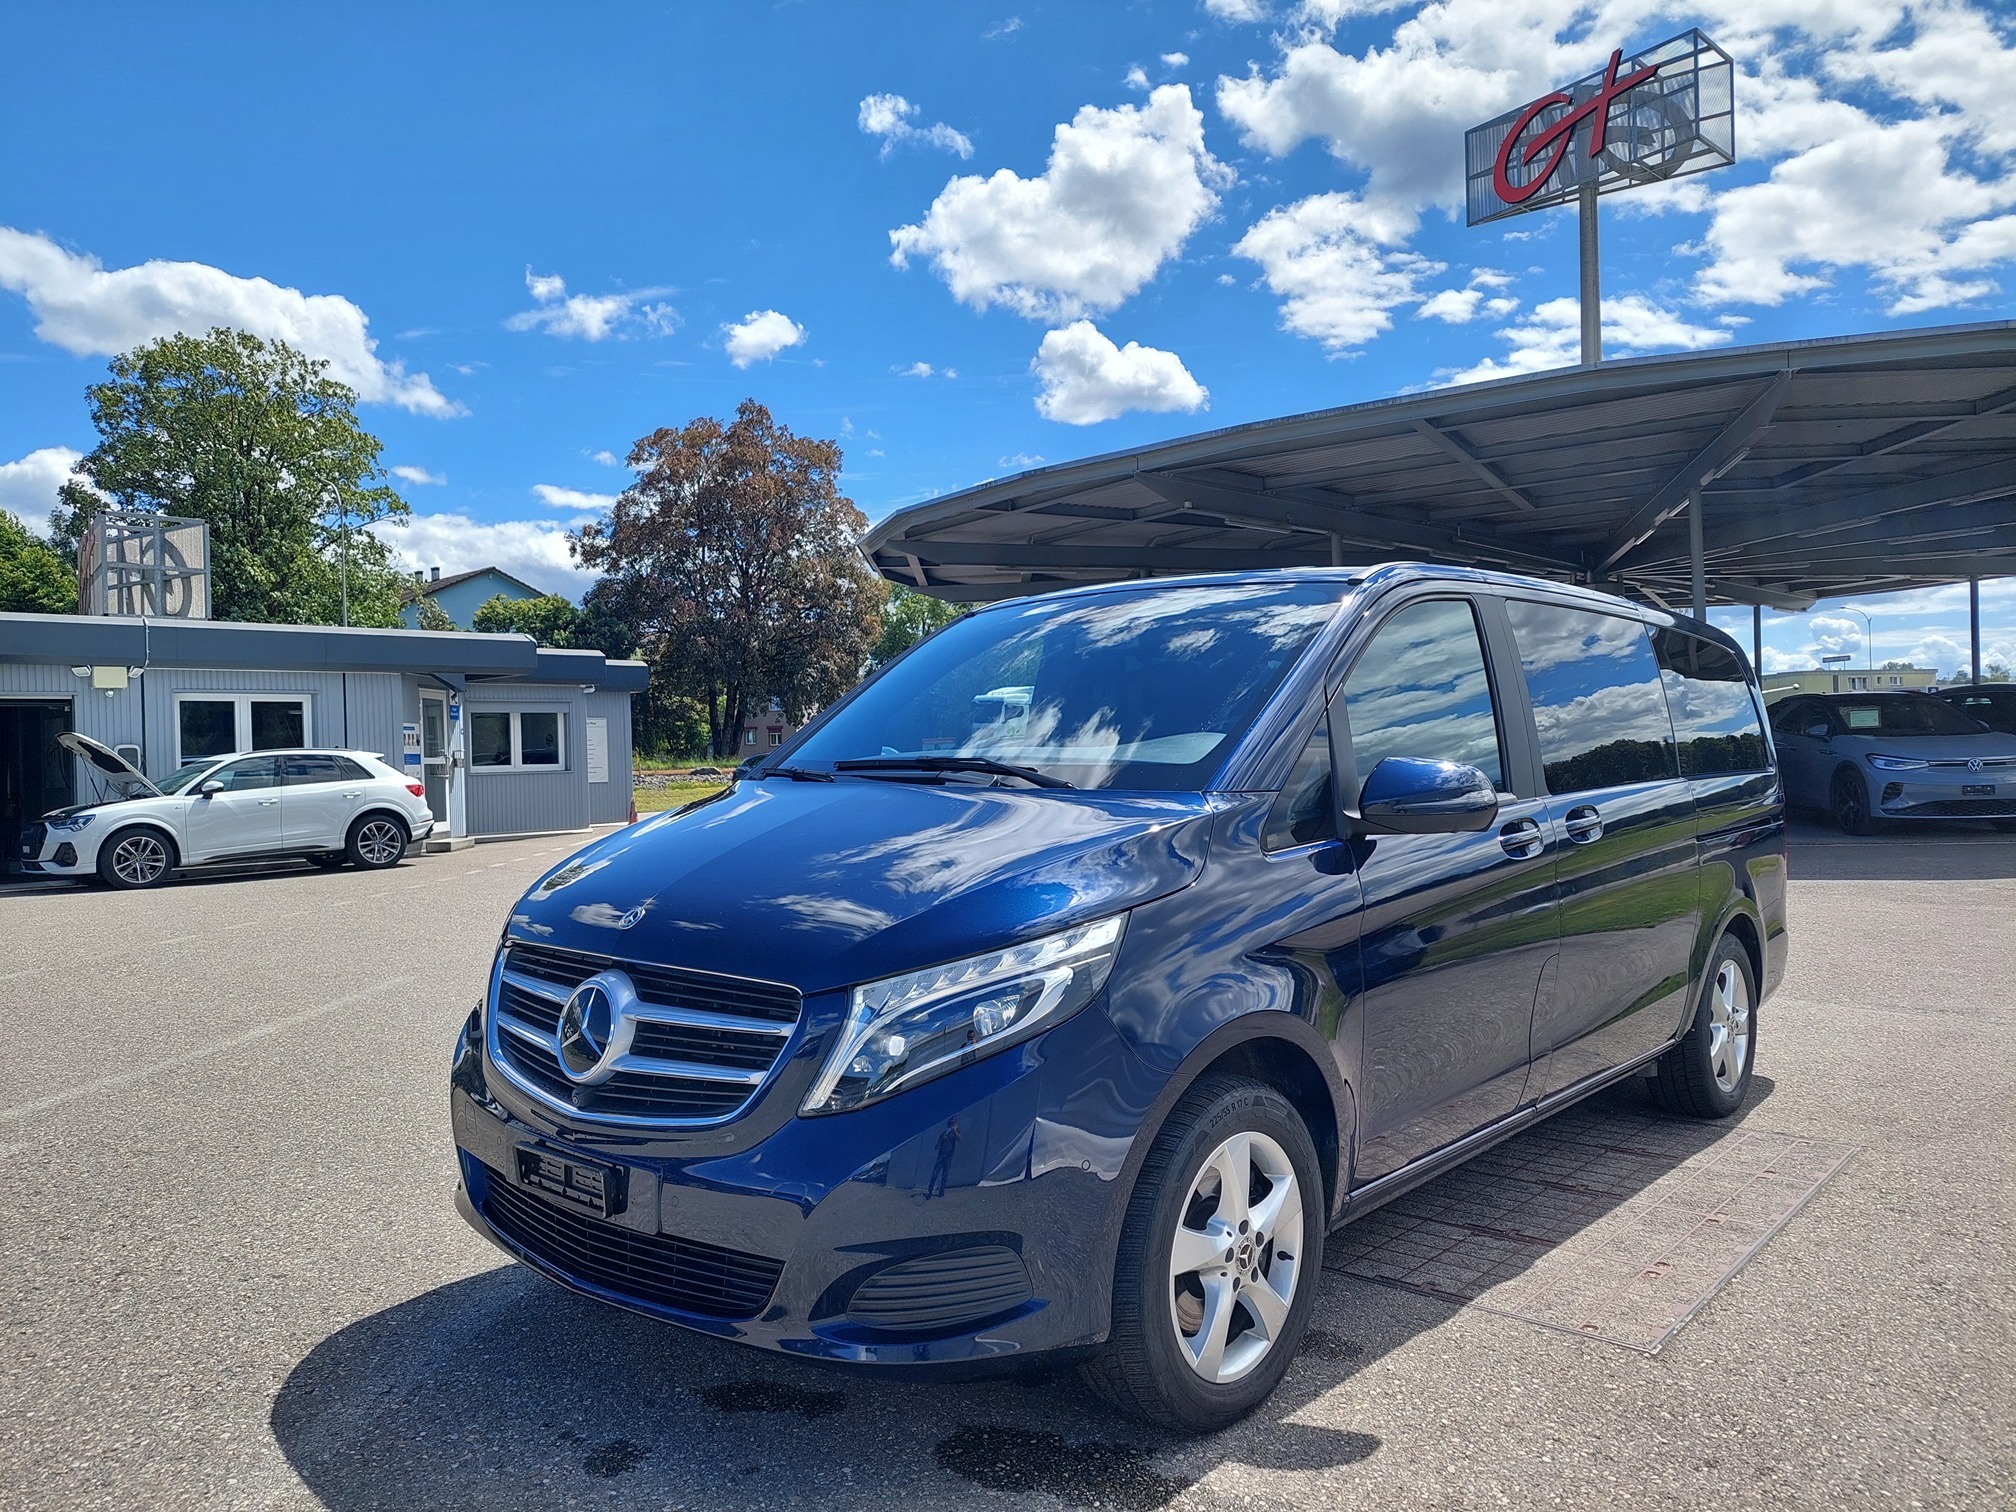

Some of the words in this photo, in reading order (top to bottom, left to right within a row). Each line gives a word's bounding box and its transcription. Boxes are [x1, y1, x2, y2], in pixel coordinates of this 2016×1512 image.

[1210, 1105, 1230, 1128] 225/55
[1231, 1102, 1236, 1111] R
[1236, 1099, 1243, 1108] 17
[1243, 1097, 1249, 1106] C
